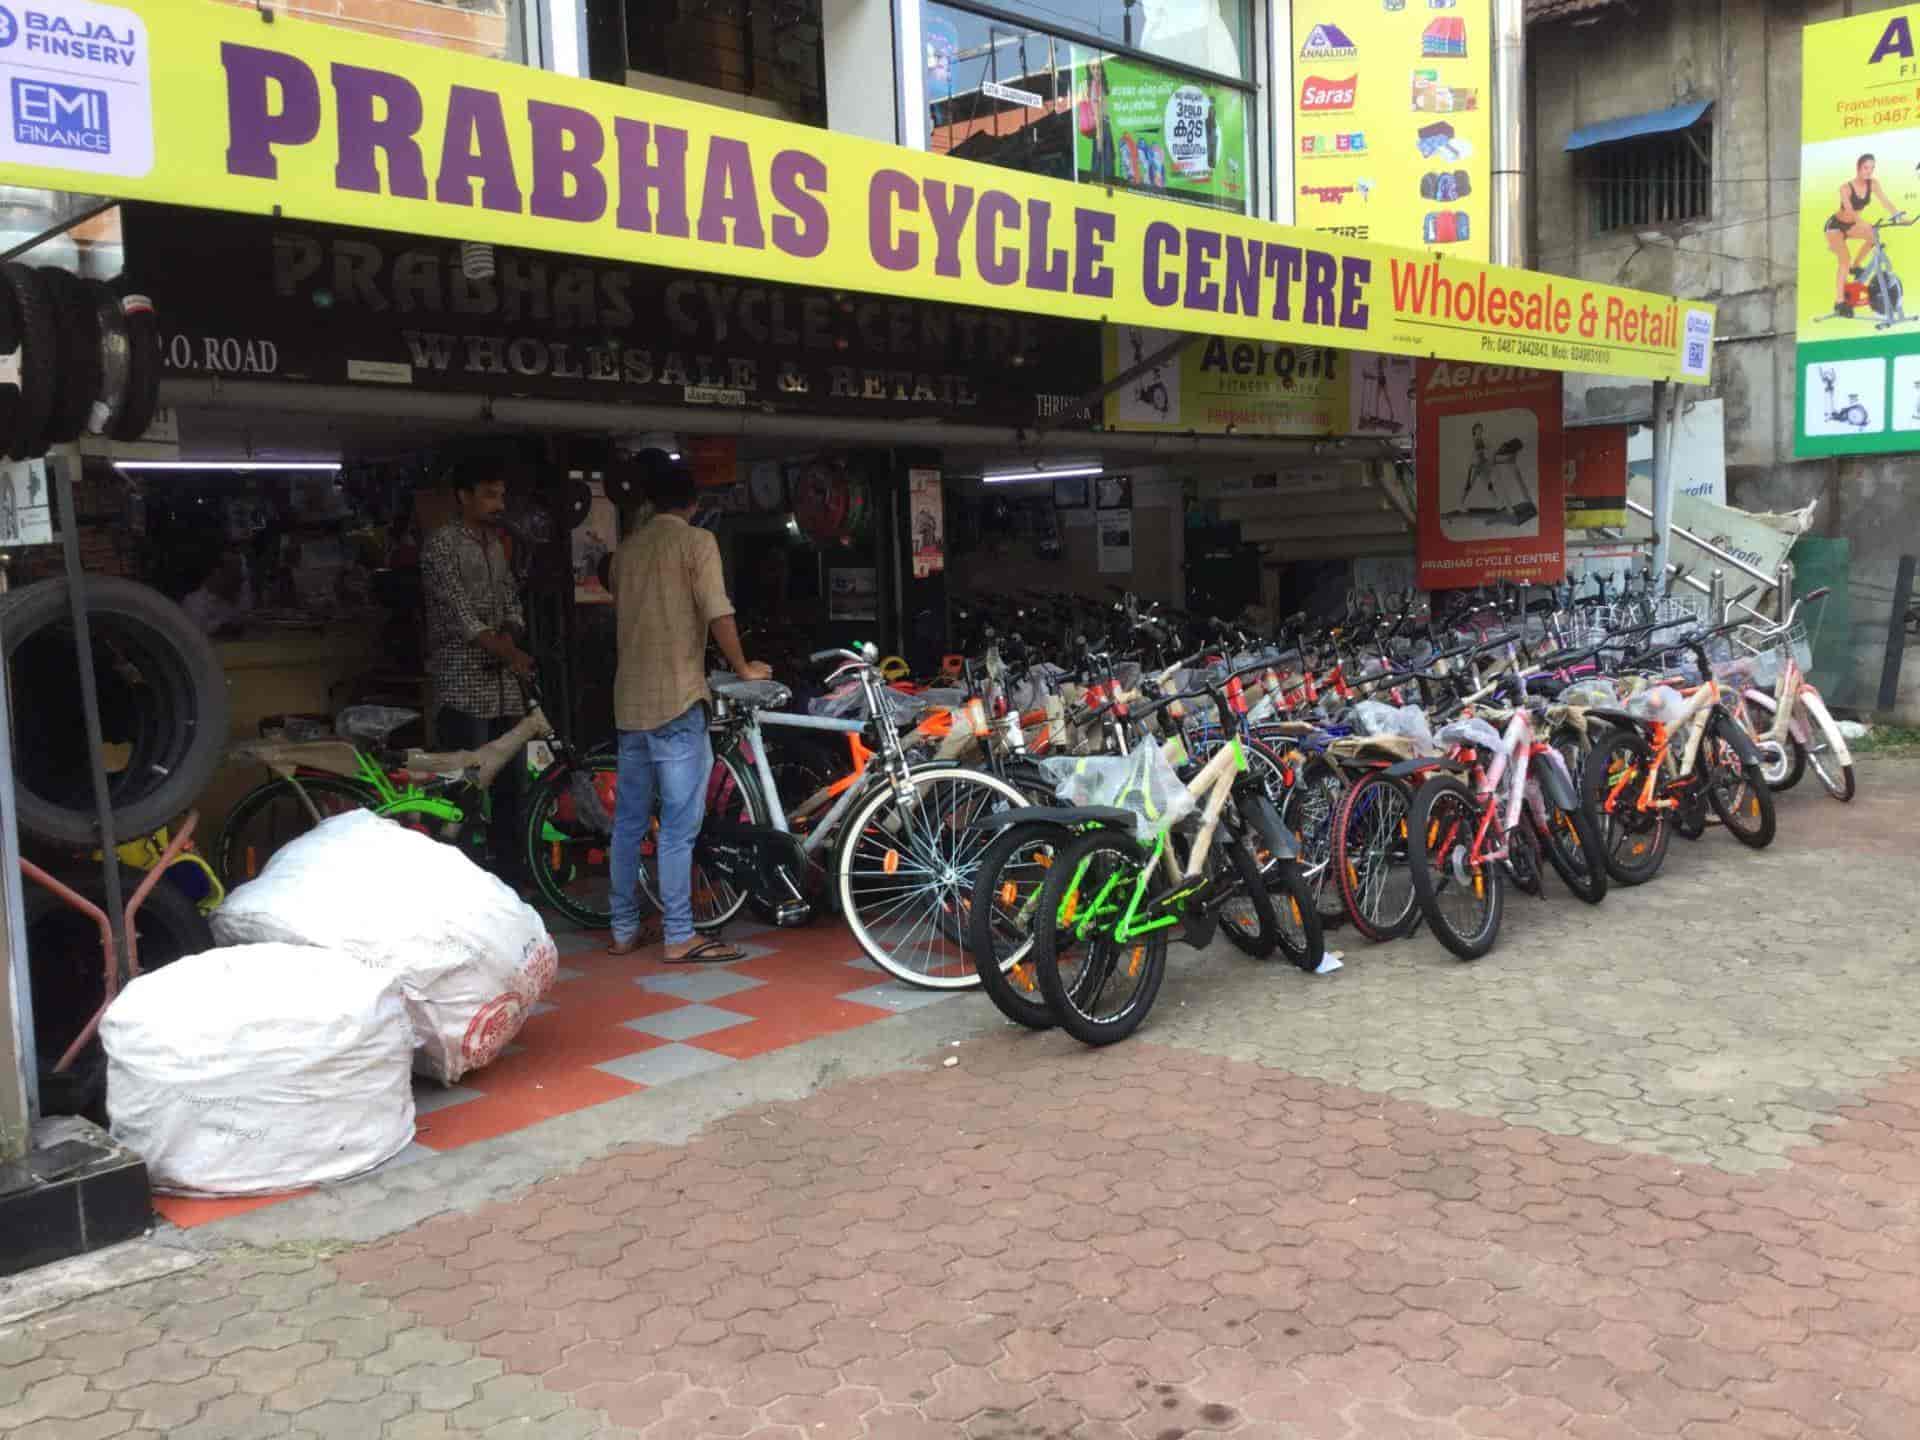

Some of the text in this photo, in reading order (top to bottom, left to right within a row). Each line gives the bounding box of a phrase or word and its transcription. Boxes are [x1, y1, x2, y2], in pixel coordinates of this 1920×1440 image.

[25, 11, 135, 46] BAJAJ
[26, 33, 136, 67] FINSERV
[18, 82, 101, 131] EMI
[1303, 87, 1354, 105] Saras
[18, 123, 108, 150] FINANCE
[220, 42, 1371, 329] PRABHAS CYCLE CENTRE
[271, 232, 633, 329] PRABHAS
[1390, 257, 1679, 350] Wholesale & Retail
[157, 333, 279, 374] .O. ROAD
[402, 330, 977, 405] WHOLESALE & RETAIL
[1475, 555, 1513, 568] CYCLE
[1514, 551, 1561, 565] CENTRE
